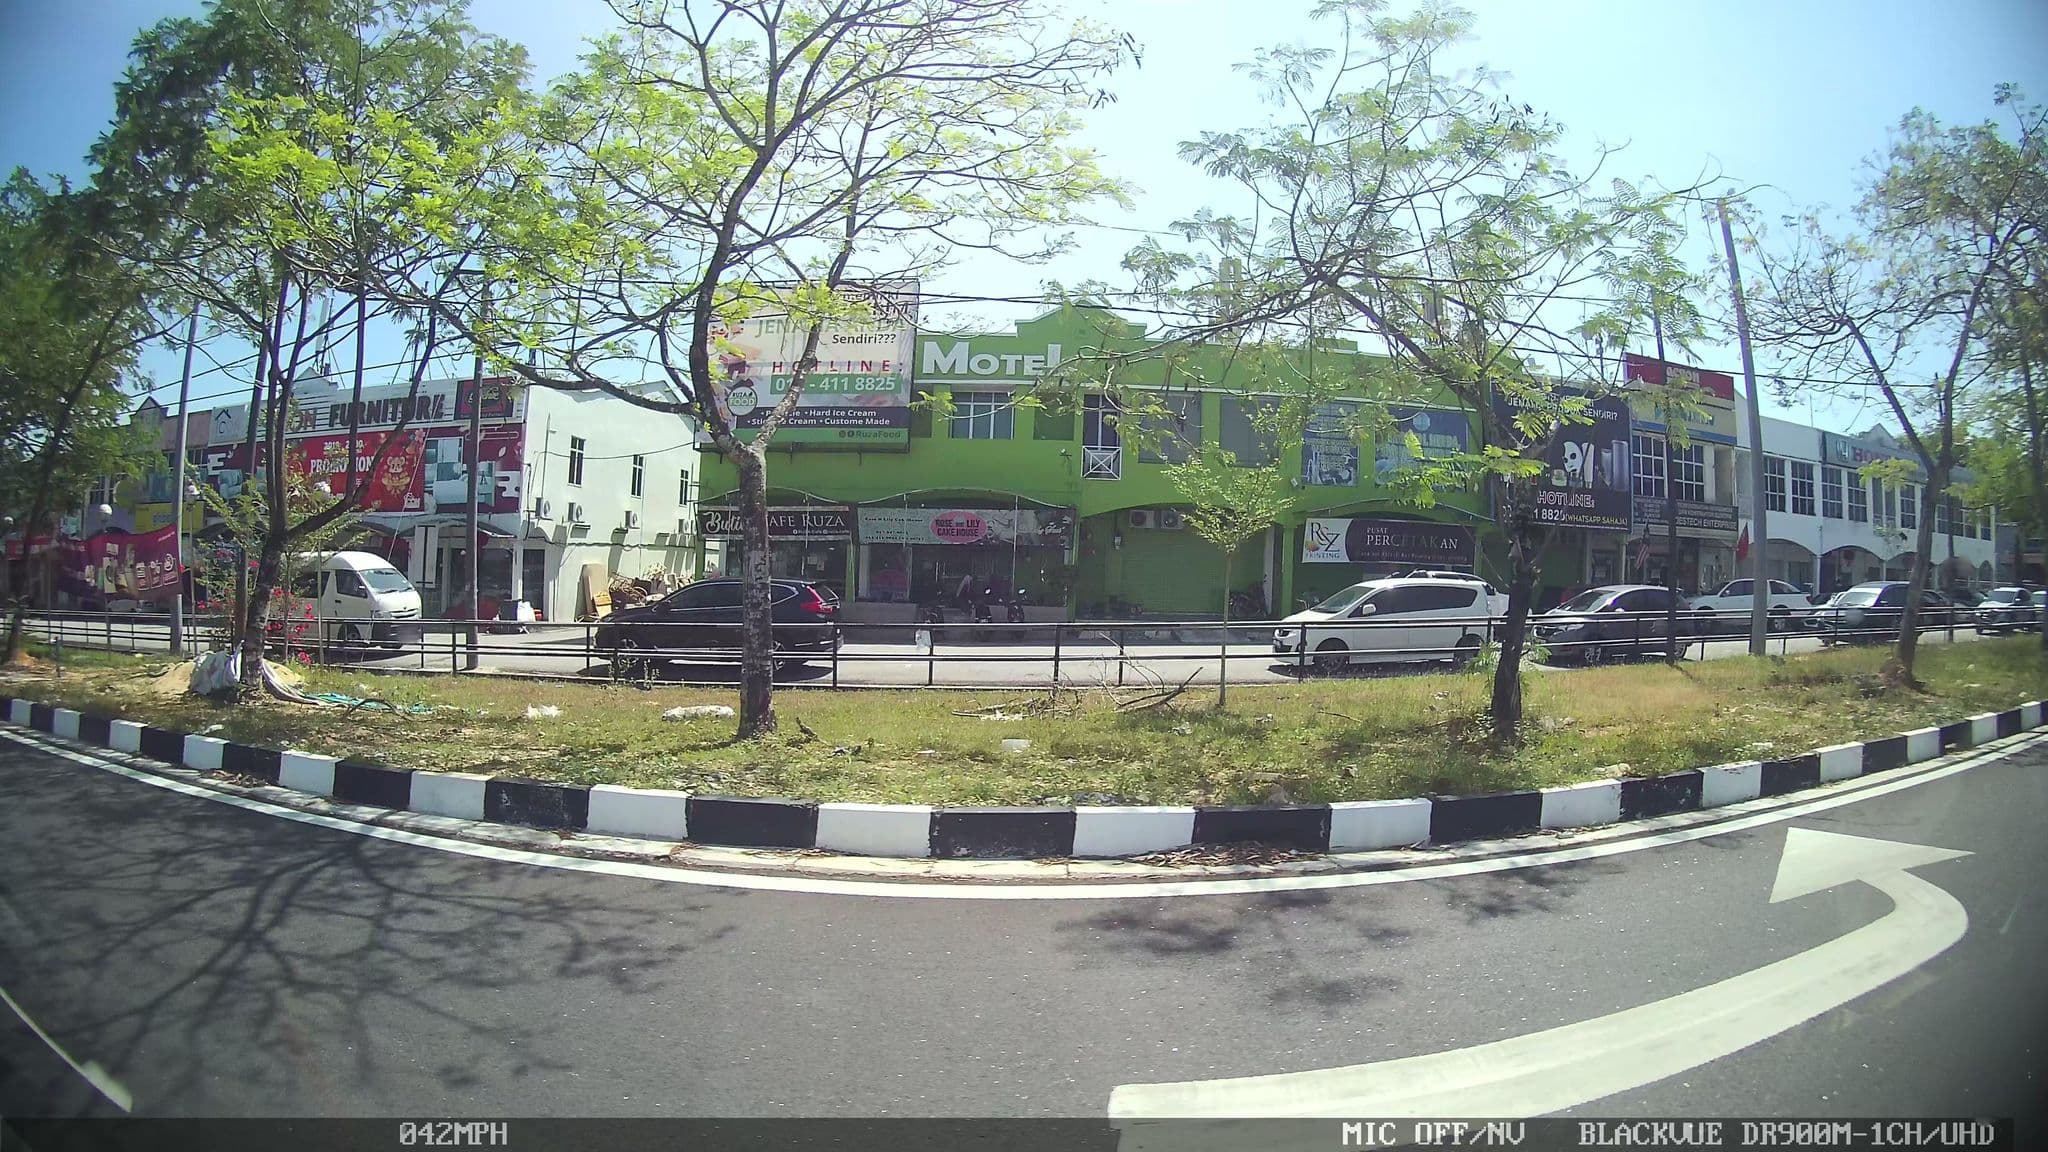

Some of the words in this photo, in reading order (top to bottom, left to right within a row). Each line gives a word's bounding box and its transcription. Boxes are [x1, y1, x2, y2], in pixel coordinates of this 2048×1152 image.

[832, 334, 897, 344] Sendiri???
[819, 378, 849, 391] 411
[854, 377, 896, 391] 8825
[809, 409, 831, 417] Hard
[833, 409, 846, 417] Ice
[848, 409, 877, 417] Cream
[788, 418, 817, 426] Cream
[824, 417, 864, 426] Custome
[866, 417, 891, 426] Made
[769, 515, 796, 527] AFE
[802, 514, 845, 528] RUZA
[966, 519, 981, 528] LILY
[937, 528, 955, 537] CAKE
[956, 528, 979, 537] HOUSE
[1366, 534, 1458, 549] PERCETAKAN
